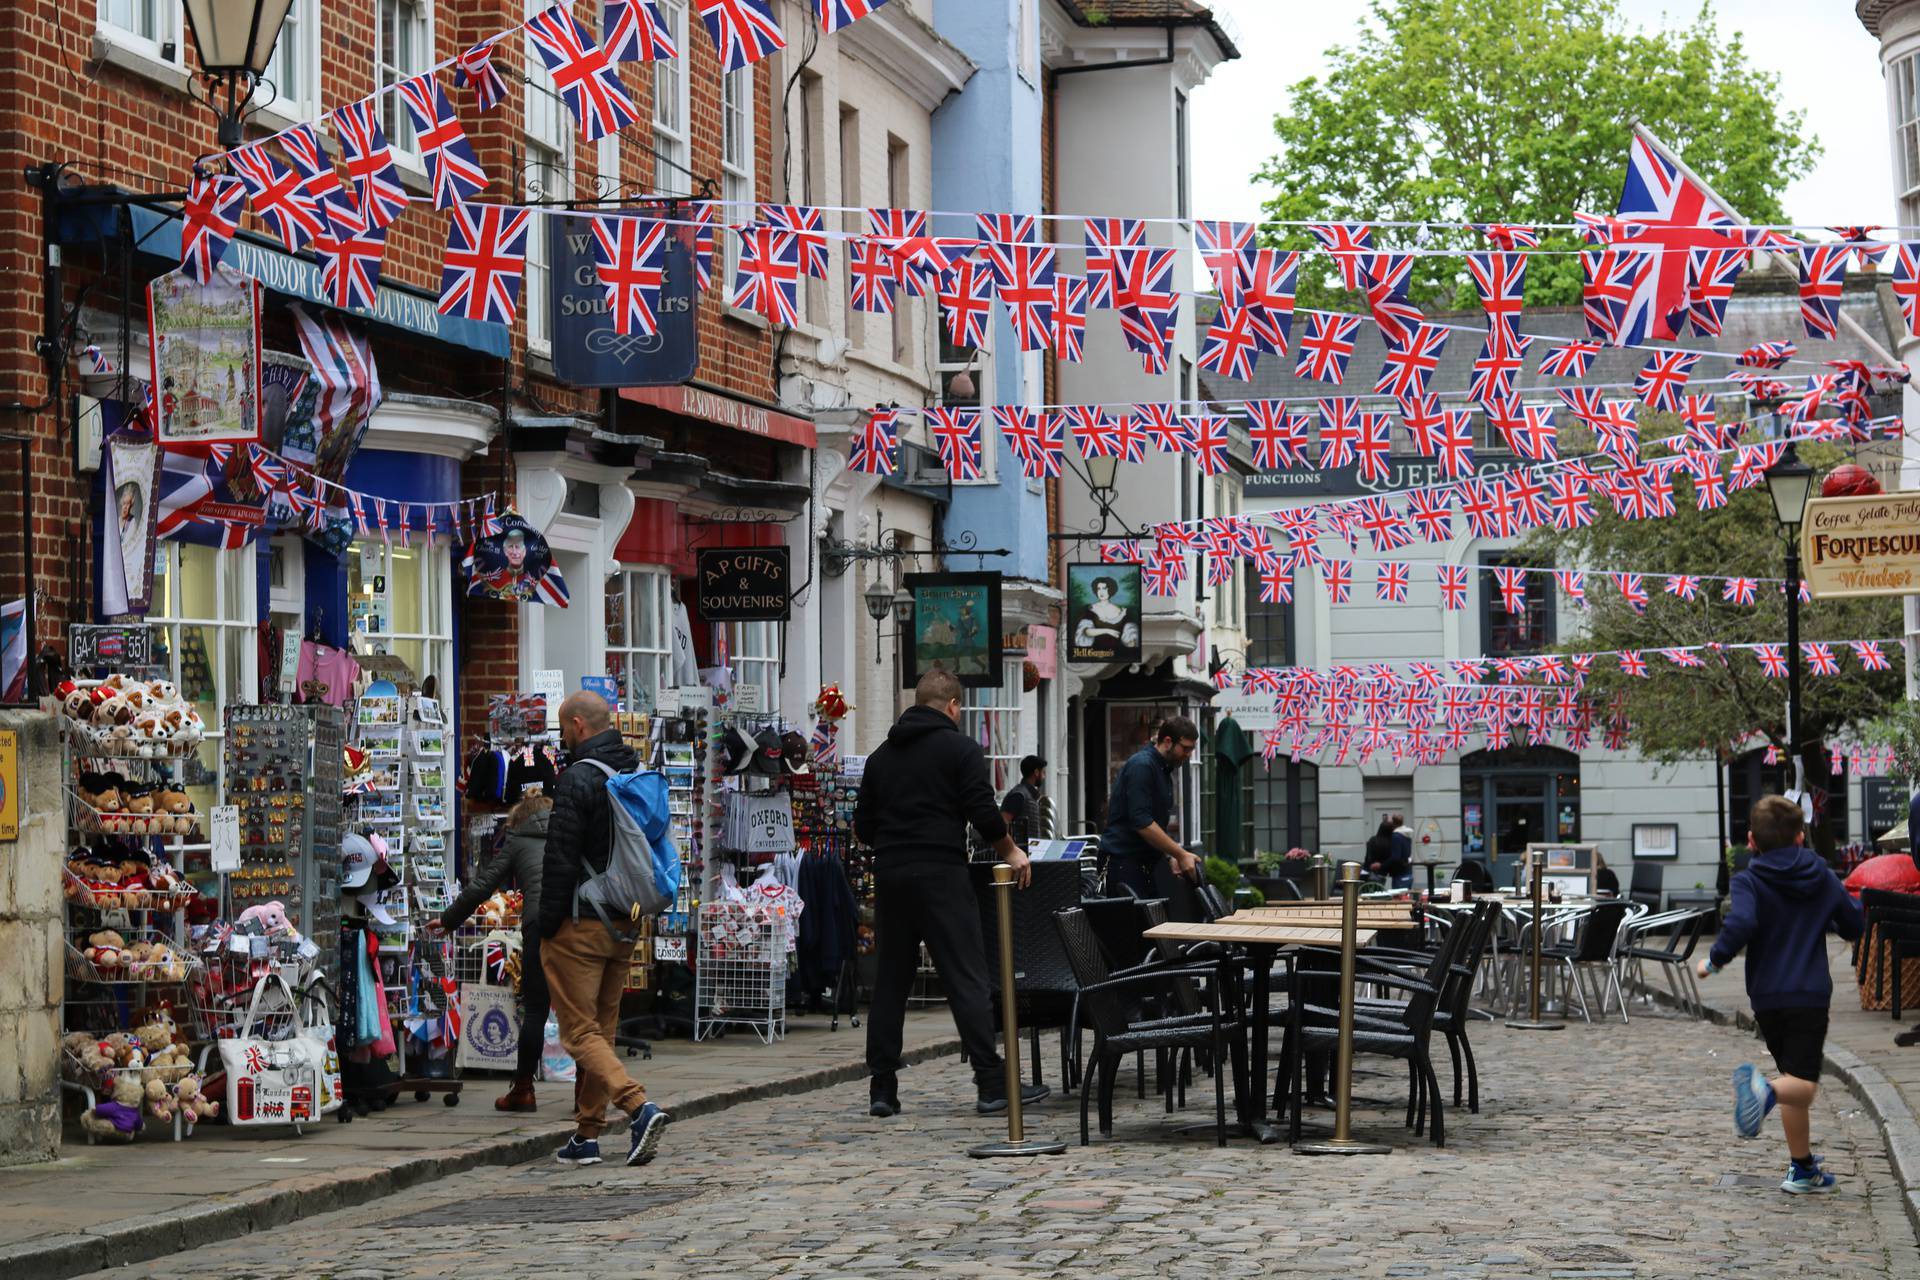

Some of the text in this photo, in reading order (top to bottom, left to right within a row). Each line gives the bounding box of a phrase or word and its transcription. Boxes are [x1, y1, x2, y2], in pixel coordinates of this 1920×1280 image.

[237, 243, 306, 296] WINDSOR
[562, 292, 689, 316] Souirs
[741, 404, 748, 428] &
[1245, 474, 1321, 485] FUNCTIONS
[1815, 499, 1920, 529] Coffee Gelato Fudg
[734, 555, 783, 580] GIFTS
[739, 577, 750, 590] &
[1839, 568, 1913, 589] Windsor
[702, 595, 785, 609] SOUVENIRS
[128, 636, 147, 658] 551
[751, 808, 789, 828] OXFORD
[1, 823, 15, 834] time
[755, 840, 788, 848] UNIVERSITY
[664, 938, 669, 948] I
[657, 948, 686, 958] LONDON
[262, 1087, 290, 1097] London
